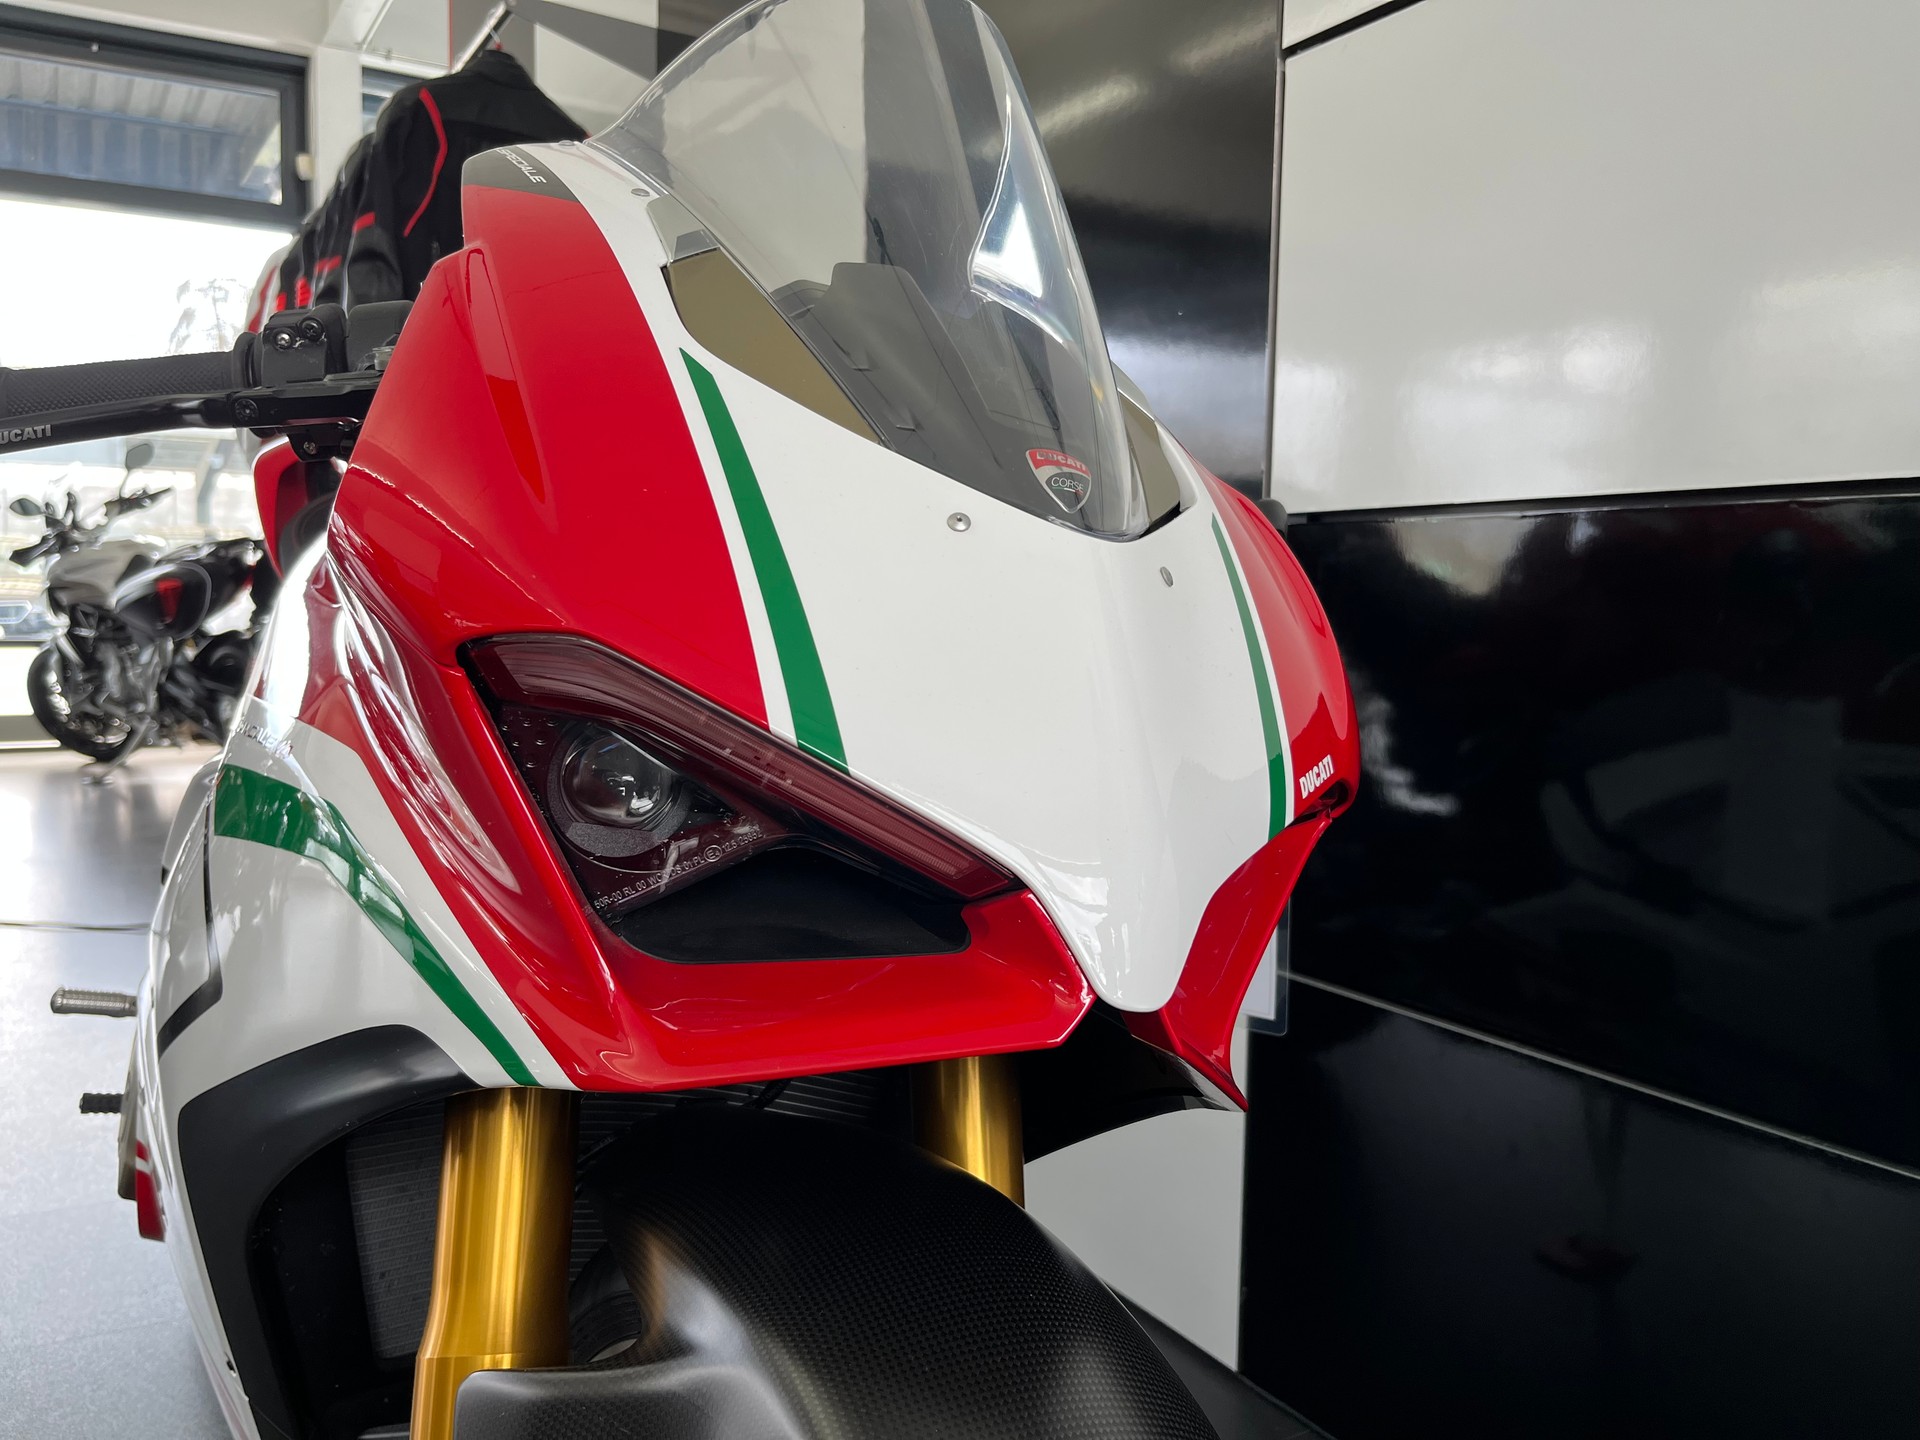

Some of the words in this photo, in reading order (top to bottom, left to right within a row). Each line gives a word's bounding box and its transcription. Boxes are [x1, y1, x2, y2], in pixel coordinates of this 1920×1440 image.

[1036, 451, 1088, 471] DUCATI
[1051, 476, 1085, 491] CORSE
[1298, 754, 1335, 799] DUCATI
